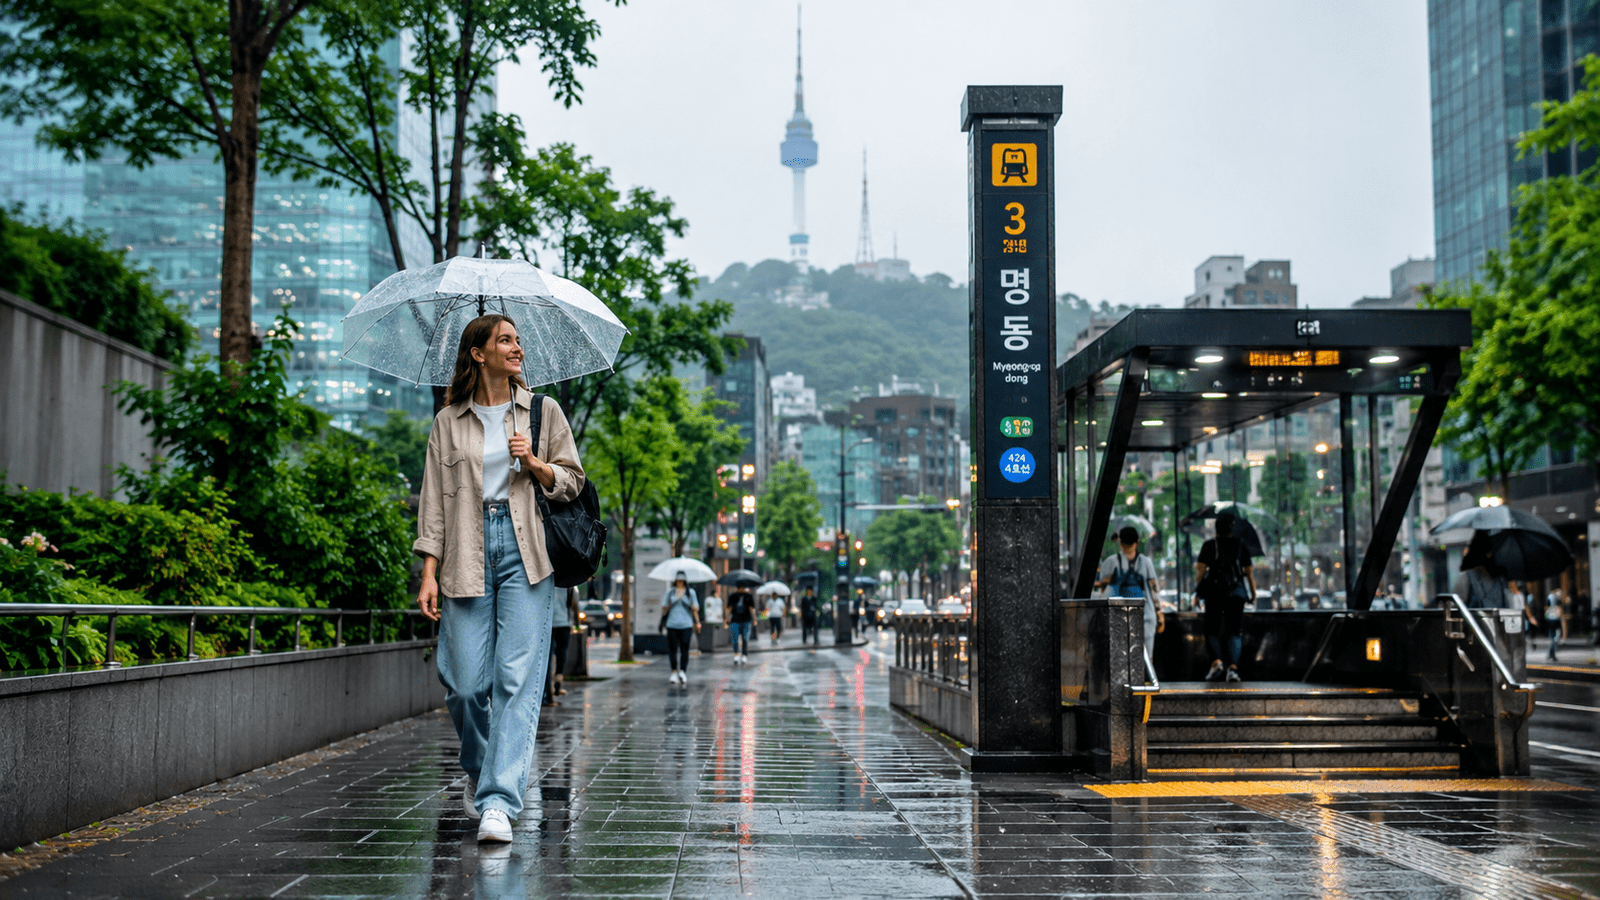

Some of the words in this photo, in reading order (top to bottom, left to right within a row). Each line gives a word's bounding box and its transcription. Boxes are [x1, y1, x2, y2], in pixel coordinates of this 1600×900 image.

[1005, 202, 1026, 235] 3
[1000, 268, 1033, 351] 명동
[1005, 373, 1028, 385] dong
